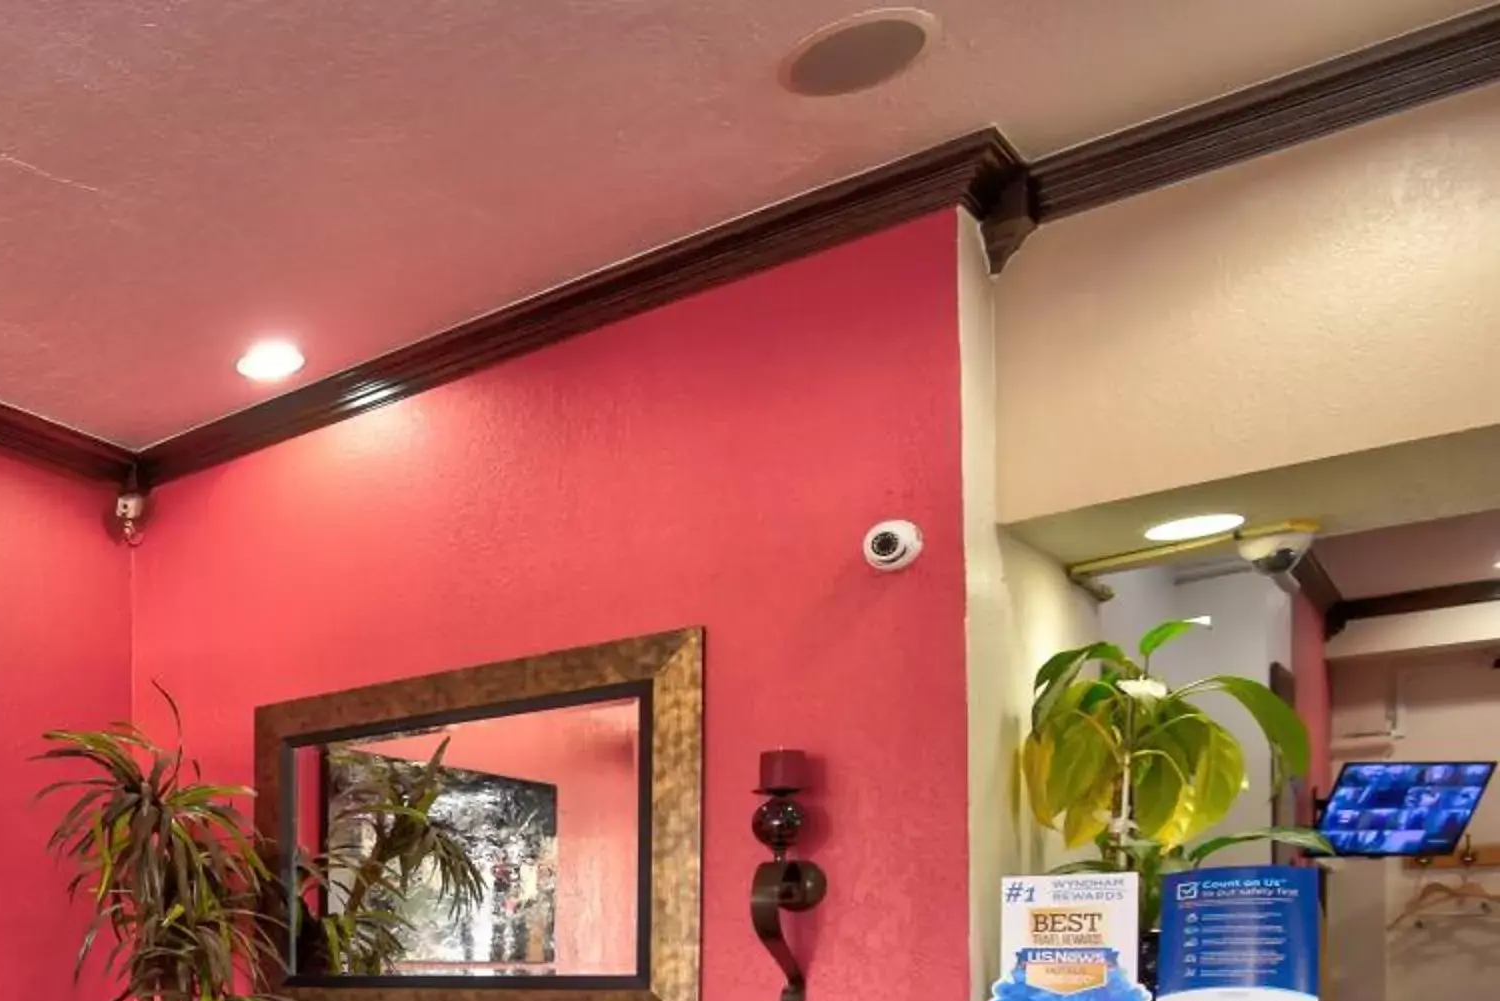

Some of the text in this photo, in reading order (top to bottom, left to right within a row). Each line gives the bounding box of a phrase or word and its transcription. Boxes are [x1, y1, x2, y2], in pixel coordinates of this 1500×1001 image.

[1006, 882, 1036, 902] #1
[1202, 879, 1241, 890] Count
[1031, 913, 1103, 933] BEST
